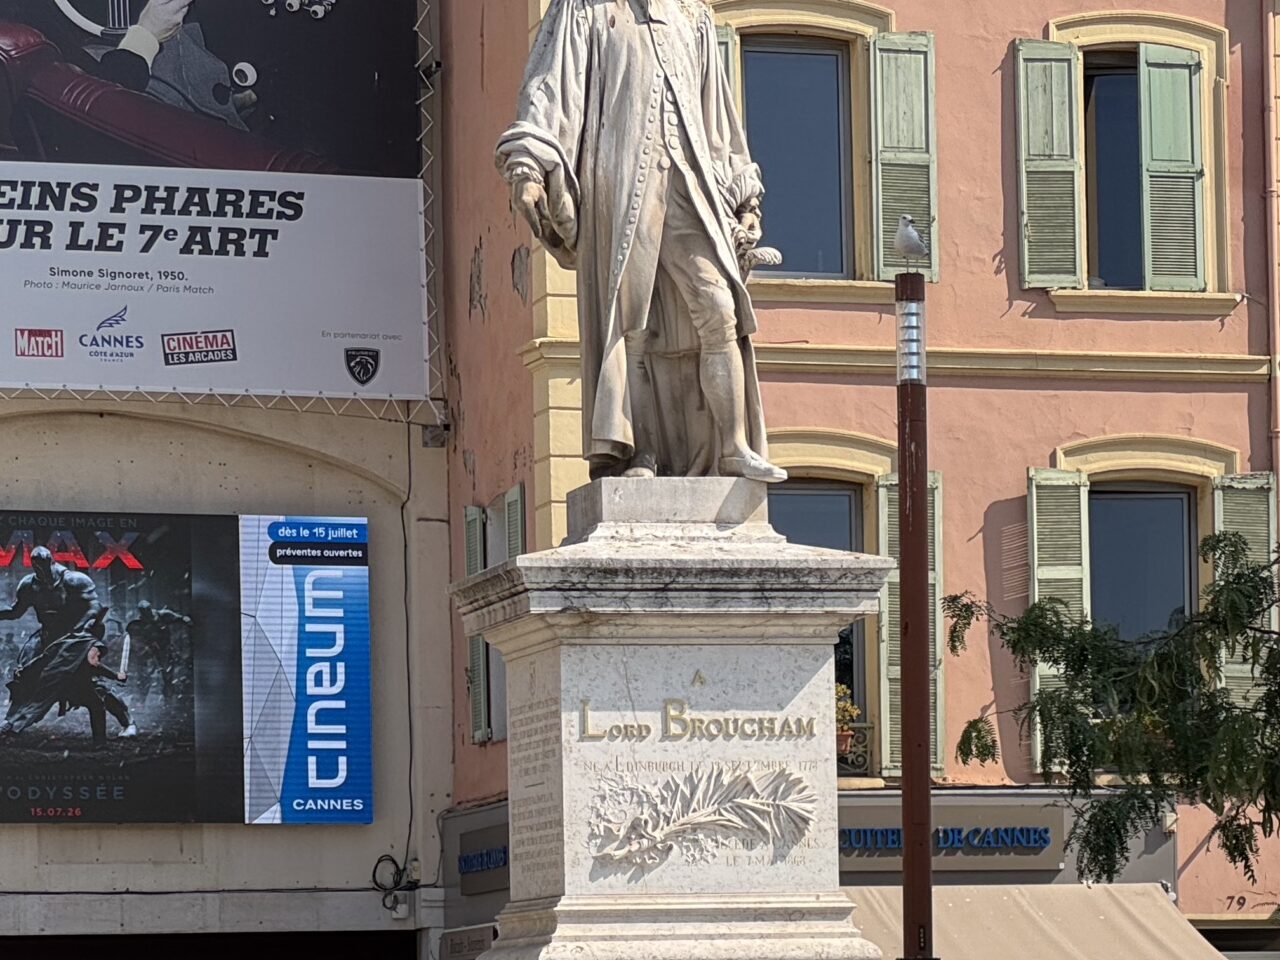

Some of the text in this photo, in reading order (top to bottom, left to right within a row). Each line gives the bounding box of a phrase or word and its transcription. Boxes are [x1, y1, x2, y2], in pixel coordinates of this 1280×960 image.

[110, 184, 305, 221] PHARES
[66, 221, 126, 252] LE
[179, 226, 279, 258] ART
[49, 267, 188, 281] Simone Signoret, 1950.
[24, 280, 53, 290] Photo
[61, 281, 101, 291] Maurice
[105, 282, 144, 292] Jarnoux
[156, 284, 180, 293] Paris
[183, 285, 214, 294] Match
[79, 334, 144, 349] CANNES
[333, 331, 380, 340] partenariat
[16, 330, 62, 357] MATCH
[168, 350, 233, 363] LES ARCADES
[9, 516, 137, 528] CHAQUE IMAGE EN
[278, 526, 358, 540] dès le 15 juillet
[276, 547, 362, 557] préventes ouvertes
[304, 569, 348, 789] cineum
[31, 807, 82, 816] 15.07.26
[293, 798, 364, 811] CANNES
[938, 826, 964, 848] DE
[968, 826, 1051, 848] CANNES
[1226, 896, 1246, 911] 79
